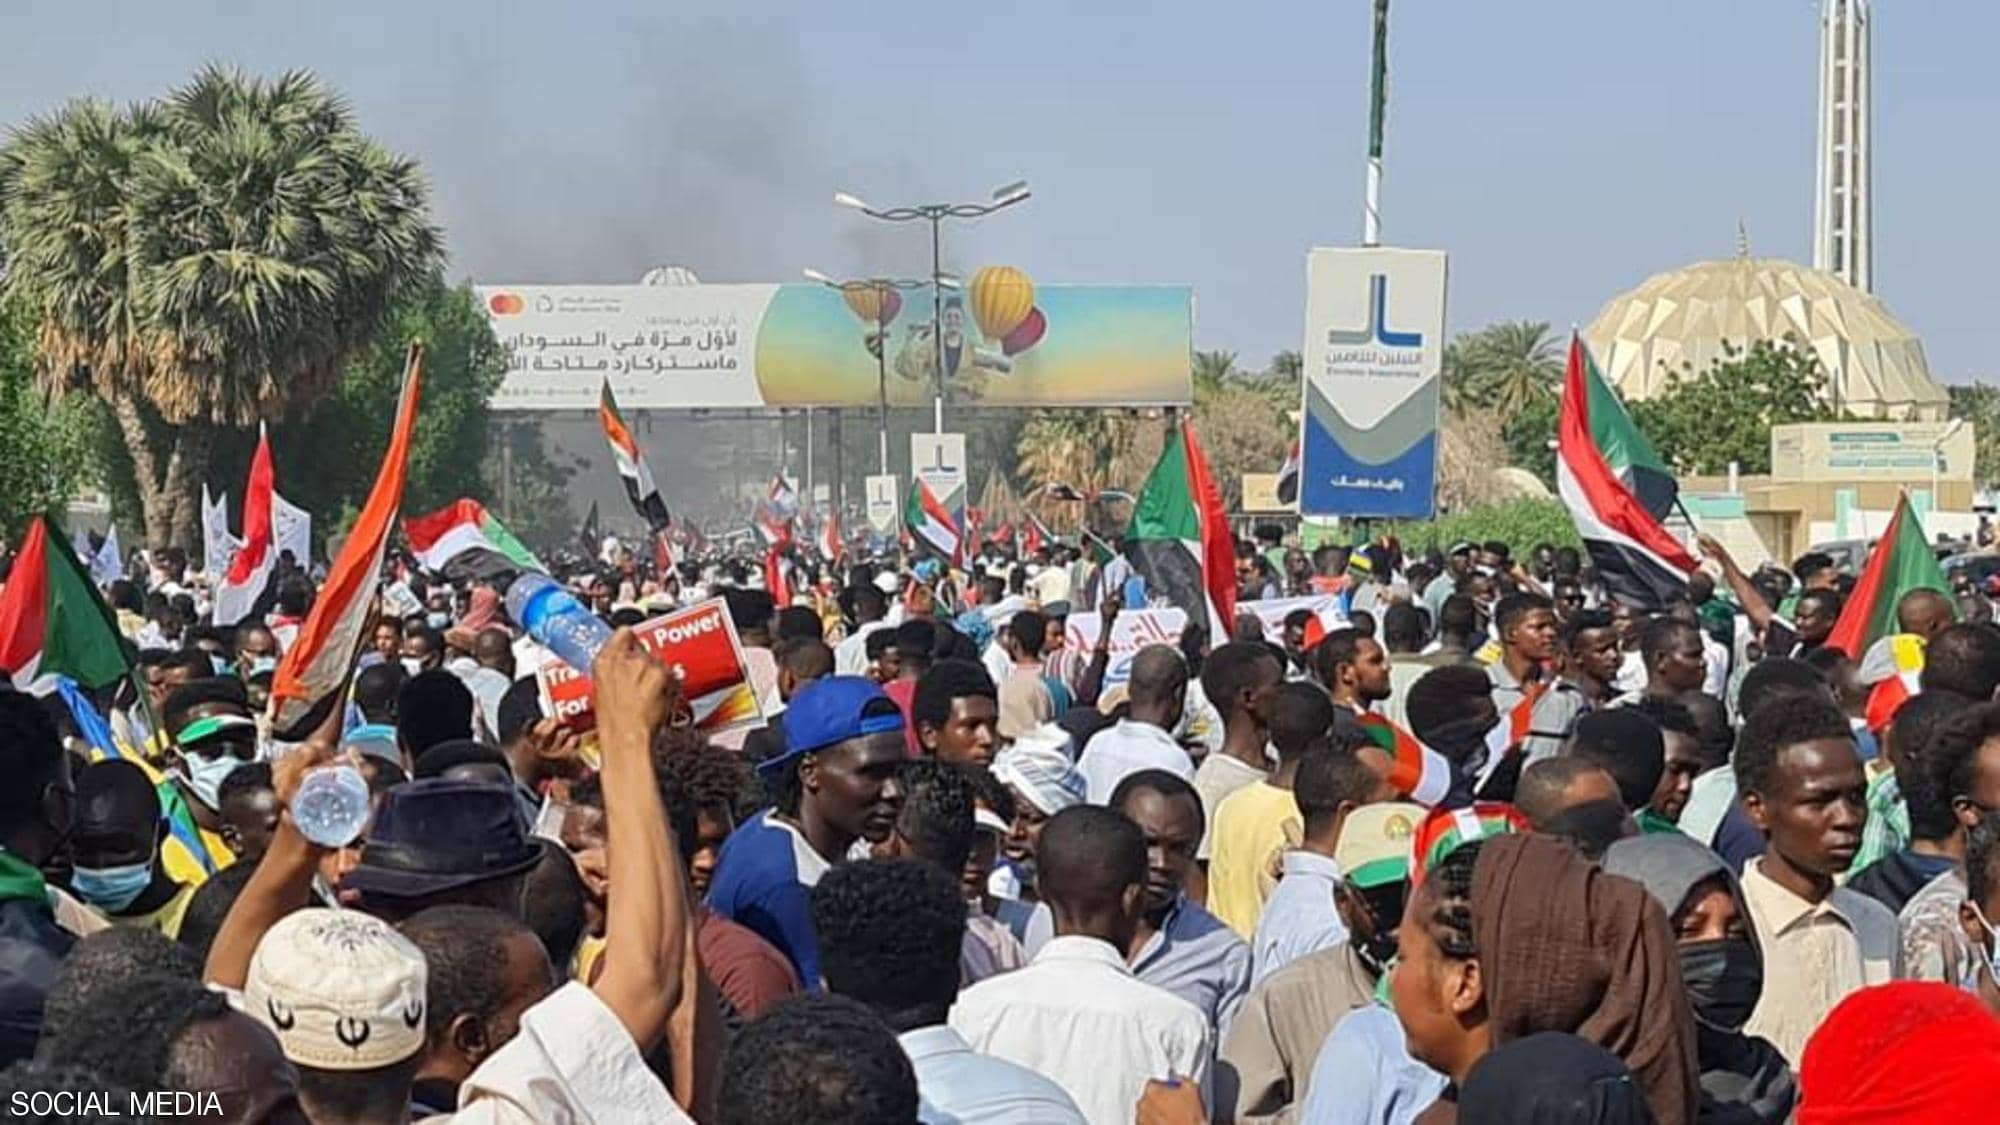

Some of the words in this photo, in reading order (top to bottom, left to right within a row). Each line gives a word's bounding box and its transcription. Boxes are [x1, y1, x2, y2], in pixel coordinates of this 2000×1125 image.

[503, 331, 608, 352] السودان
[611, 330, 645, 354] في
[533, 355, 608, 370] متاحة
[612, 354, 737, 374] ماستركارد
[654, 611, 721, 649] Power
[555, 695, 590, 722] For
